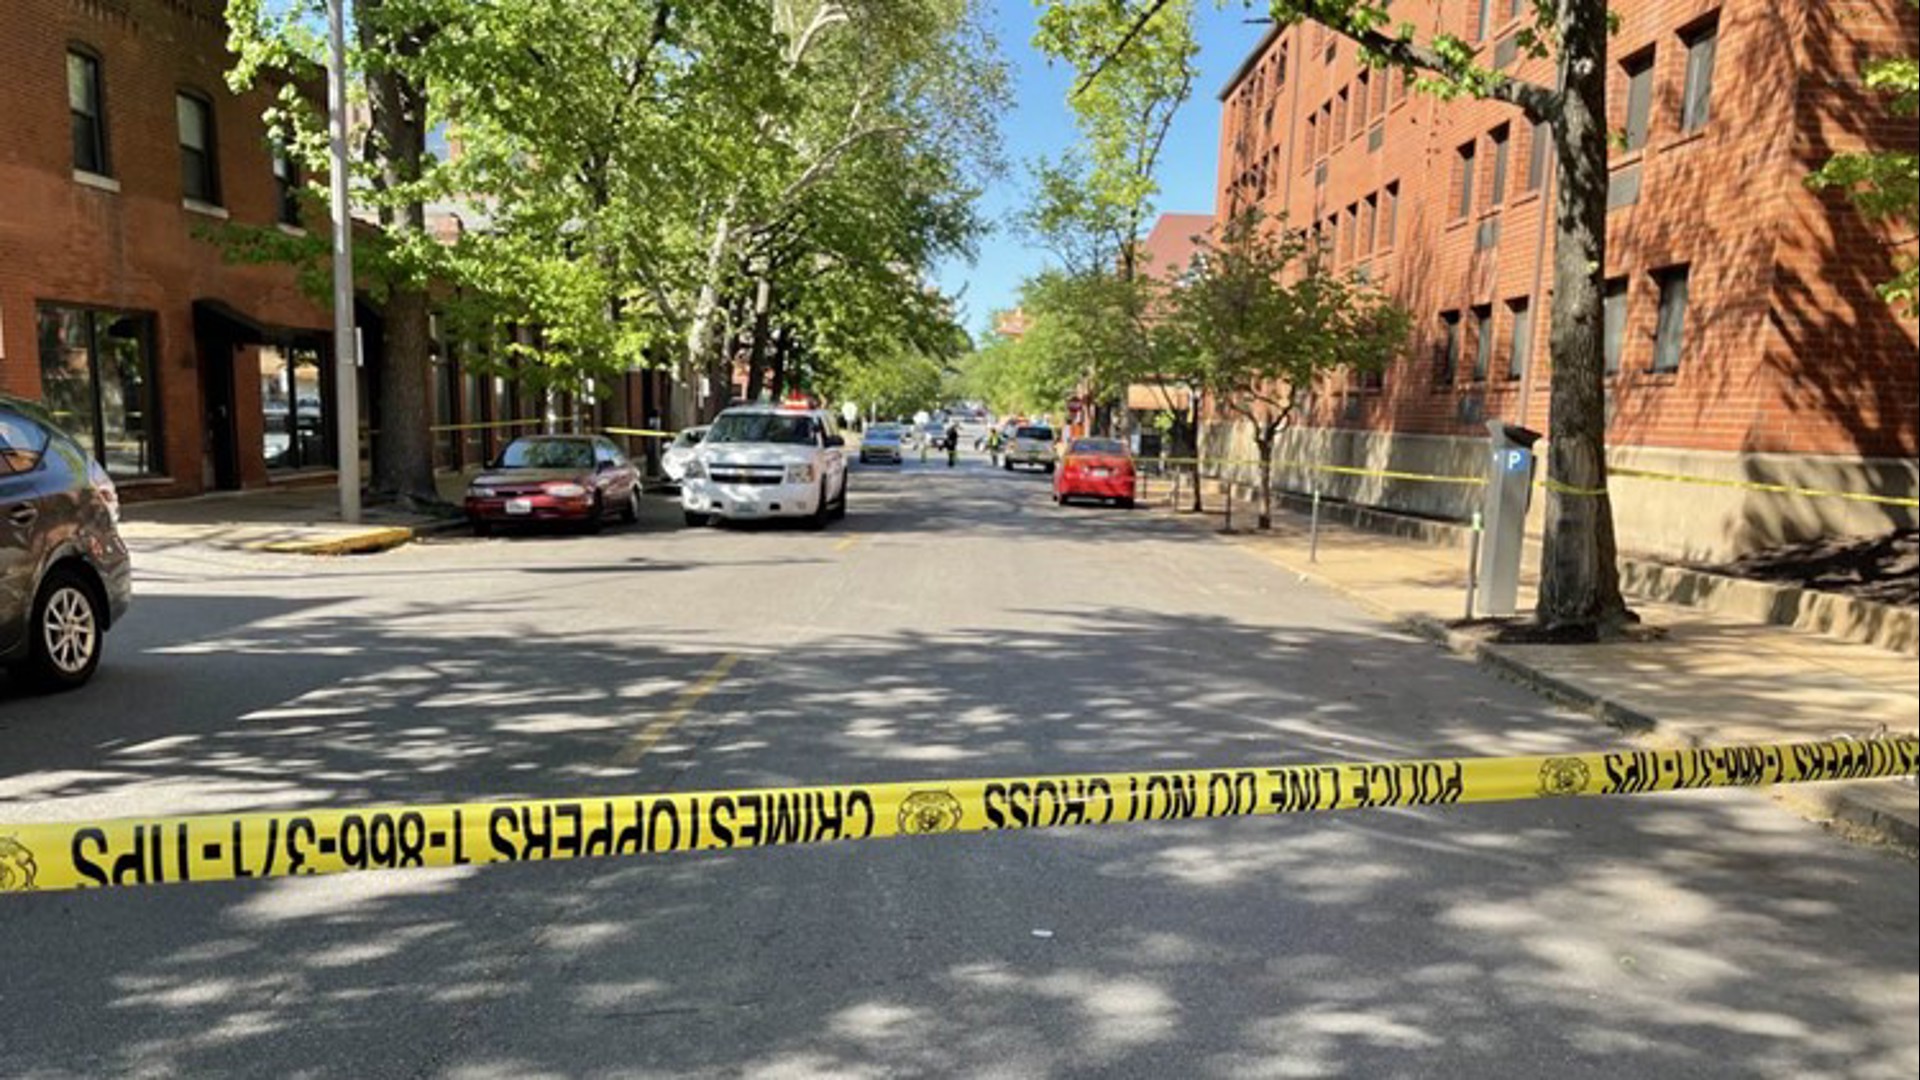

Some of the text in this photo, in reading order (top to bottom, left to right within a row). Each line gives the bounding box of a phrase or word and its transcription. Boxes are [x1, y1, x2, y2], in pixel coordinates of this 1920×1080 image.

[1508, 452, 1521, 470] P
[488, 790, 875, 862] CRIMESTOPPERS
[983, 761, 1464, 830] POLICE LINE DO NOT CROSS
